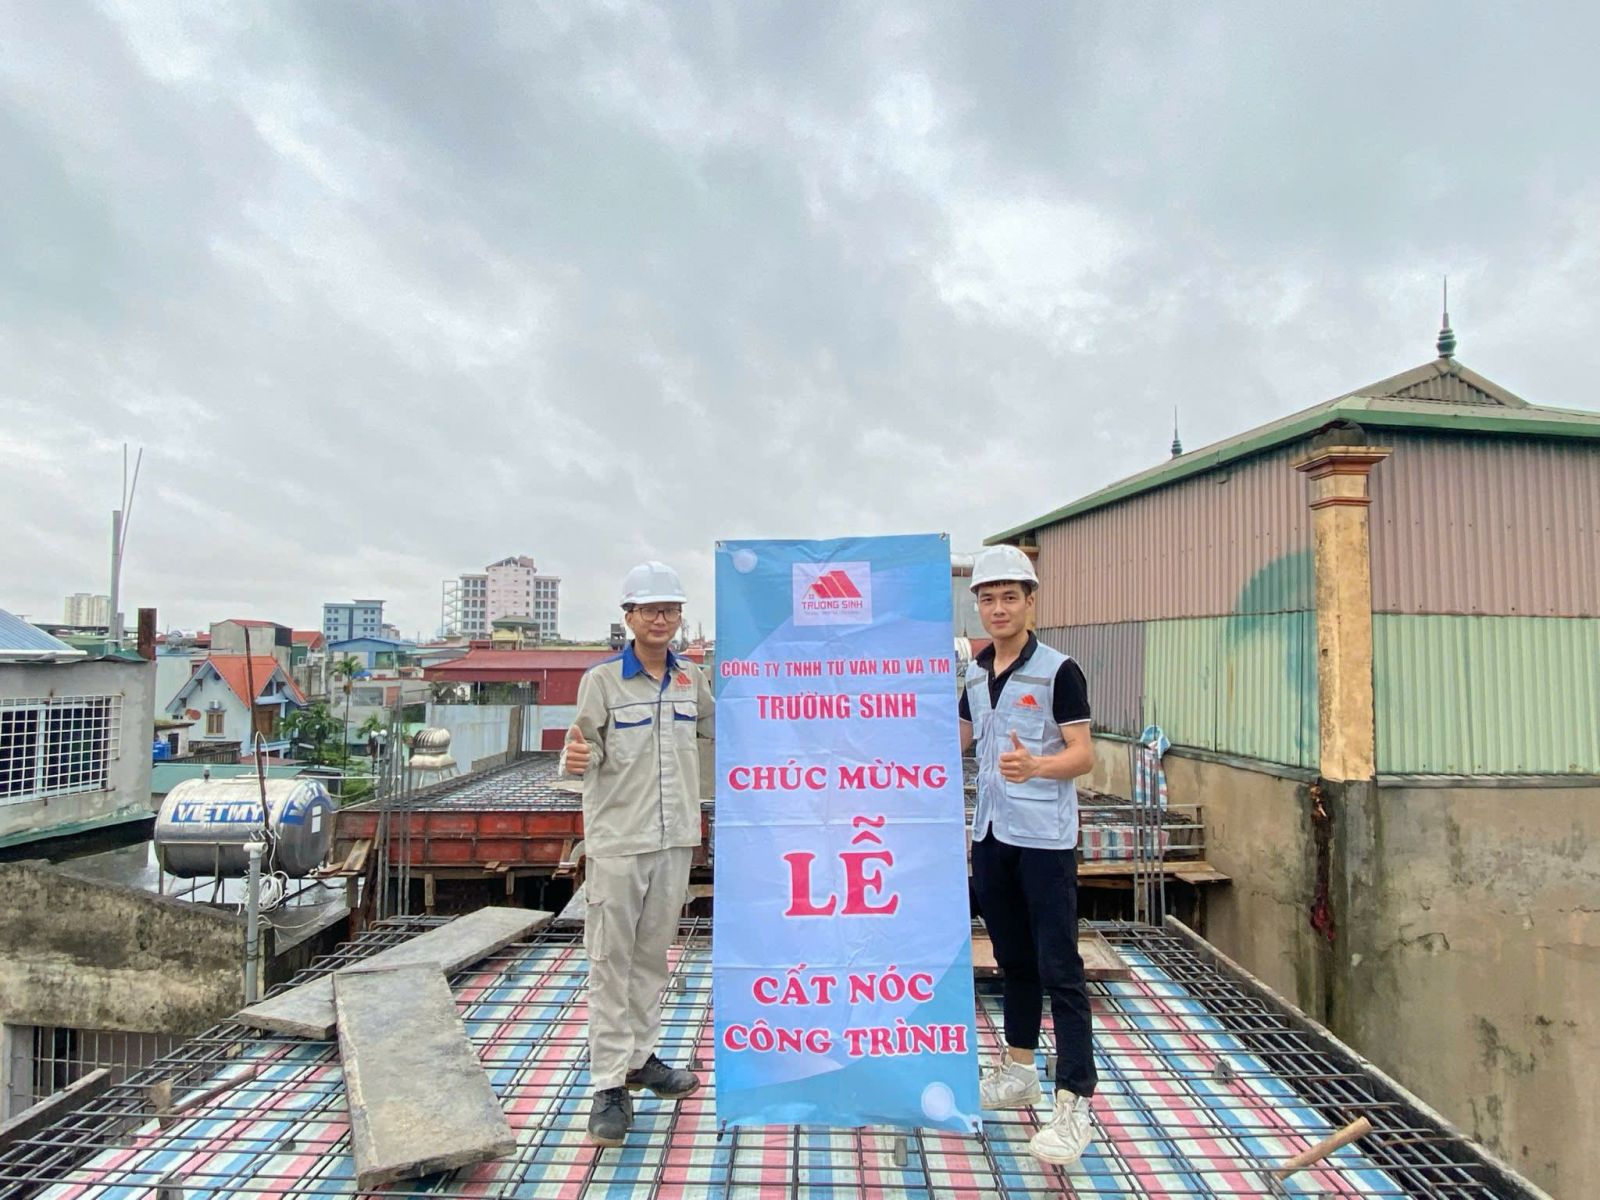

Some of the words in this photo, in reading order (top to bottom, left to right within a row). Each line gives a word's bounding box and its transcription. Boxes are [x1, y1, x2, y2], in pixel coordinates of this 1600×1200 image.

[841, 599, 863, 609] SINH
[721, 657, 760, 677] CÔNG
[764, 662, 780, 678] TY
[785, 660, 822, 677] TNHH
[929, 658, 950, 674] TM
[756, 689, 850, 720] TRƯỜNG
[859, 693, 917, 719] SINH
[728, 759, 827, 790] CHÚC
[838, 758, 948, 790] MỪNG
[783, 815, 899, 917] LỄ
[753, 963, 837, 1005] CẤT
[849, 965, 934, 1004] NÓC
[724, 1019, 833, 1054] CÔNG
[844, 1018, 968, 1057] TRÌNH
